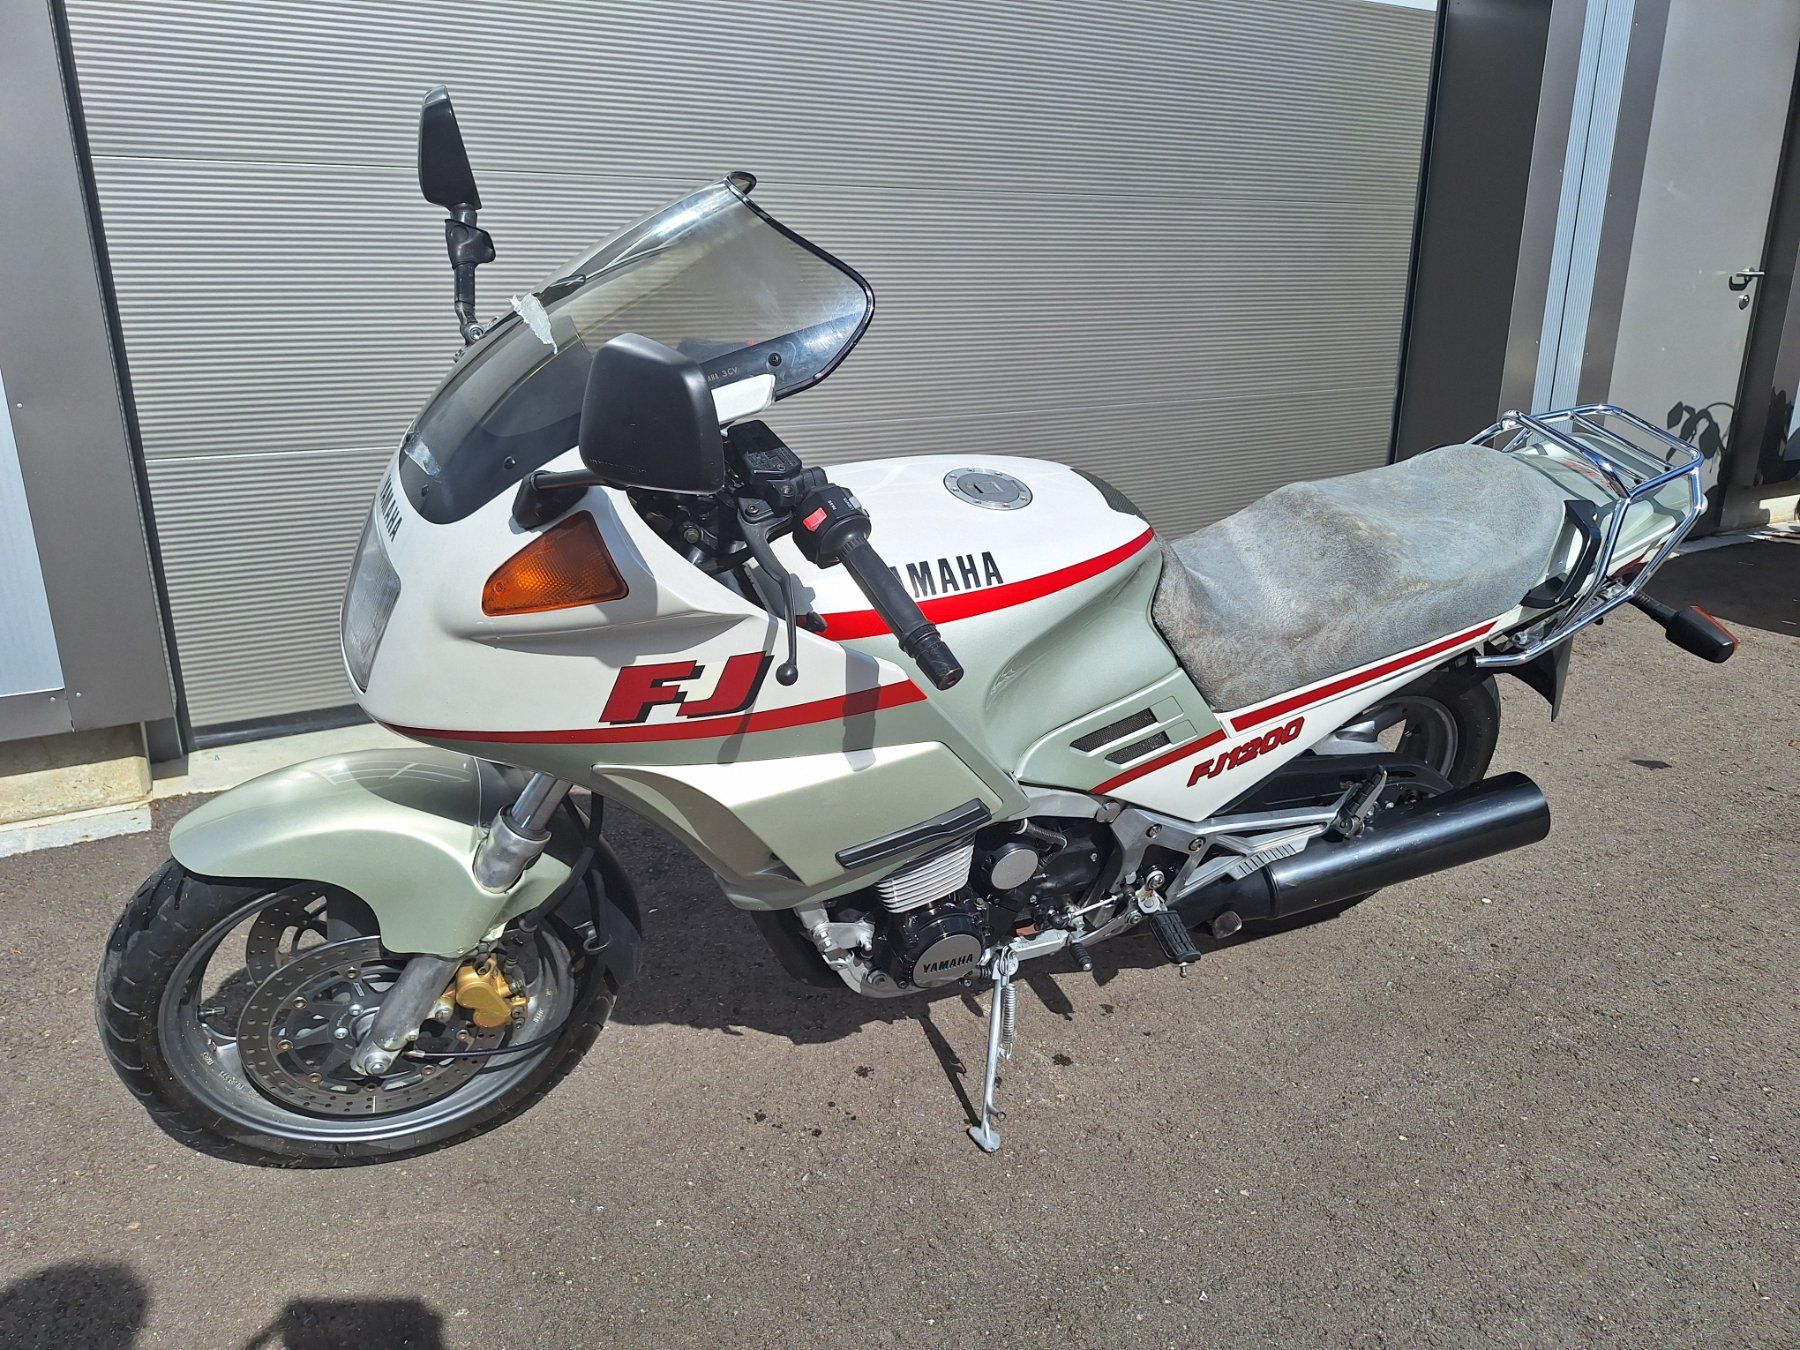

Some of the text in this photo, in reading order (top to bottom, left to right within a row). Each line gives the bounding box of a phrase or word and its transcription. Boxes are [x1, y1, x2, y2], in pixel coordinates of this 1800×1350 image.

[380, 474, 403, 542] YAMAHA
[888, 551, 1004, 598] MAHA
[598, 650, 775, 726] FJ
[1186, 716, 1305, 788] FJ1200
[923, 953, 974, 974] YAMAHA
